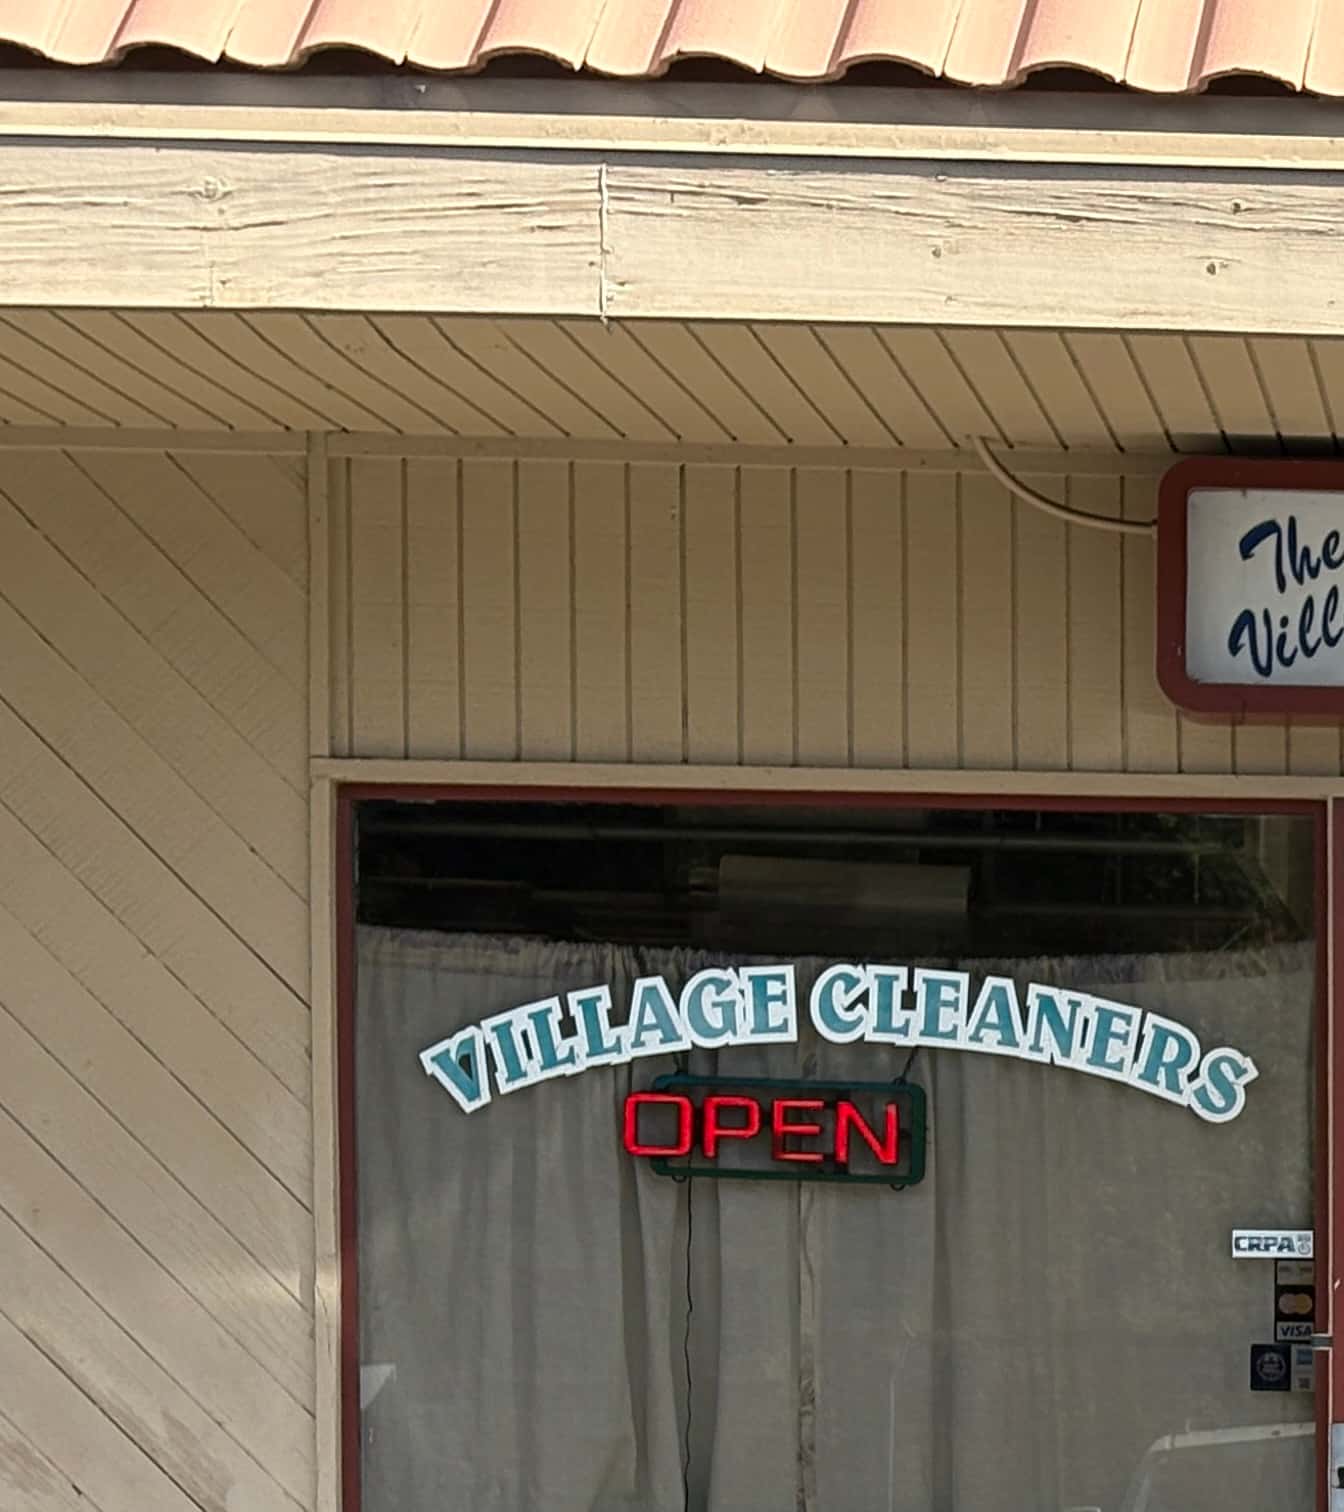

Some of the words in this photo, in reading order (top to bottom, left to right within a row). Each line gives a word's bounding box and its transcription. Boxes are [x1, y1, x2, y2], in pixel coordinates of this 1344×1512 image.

[419, 964, 798, 1114] VILLAGE
[810, 963, 1258, 1124] CLEANERS
[622, 1090, 902, 1167] OPEN
[1234, 1235, 1296, 1252] CRPA
[1280, 1325, 1312, 1337] VISA
